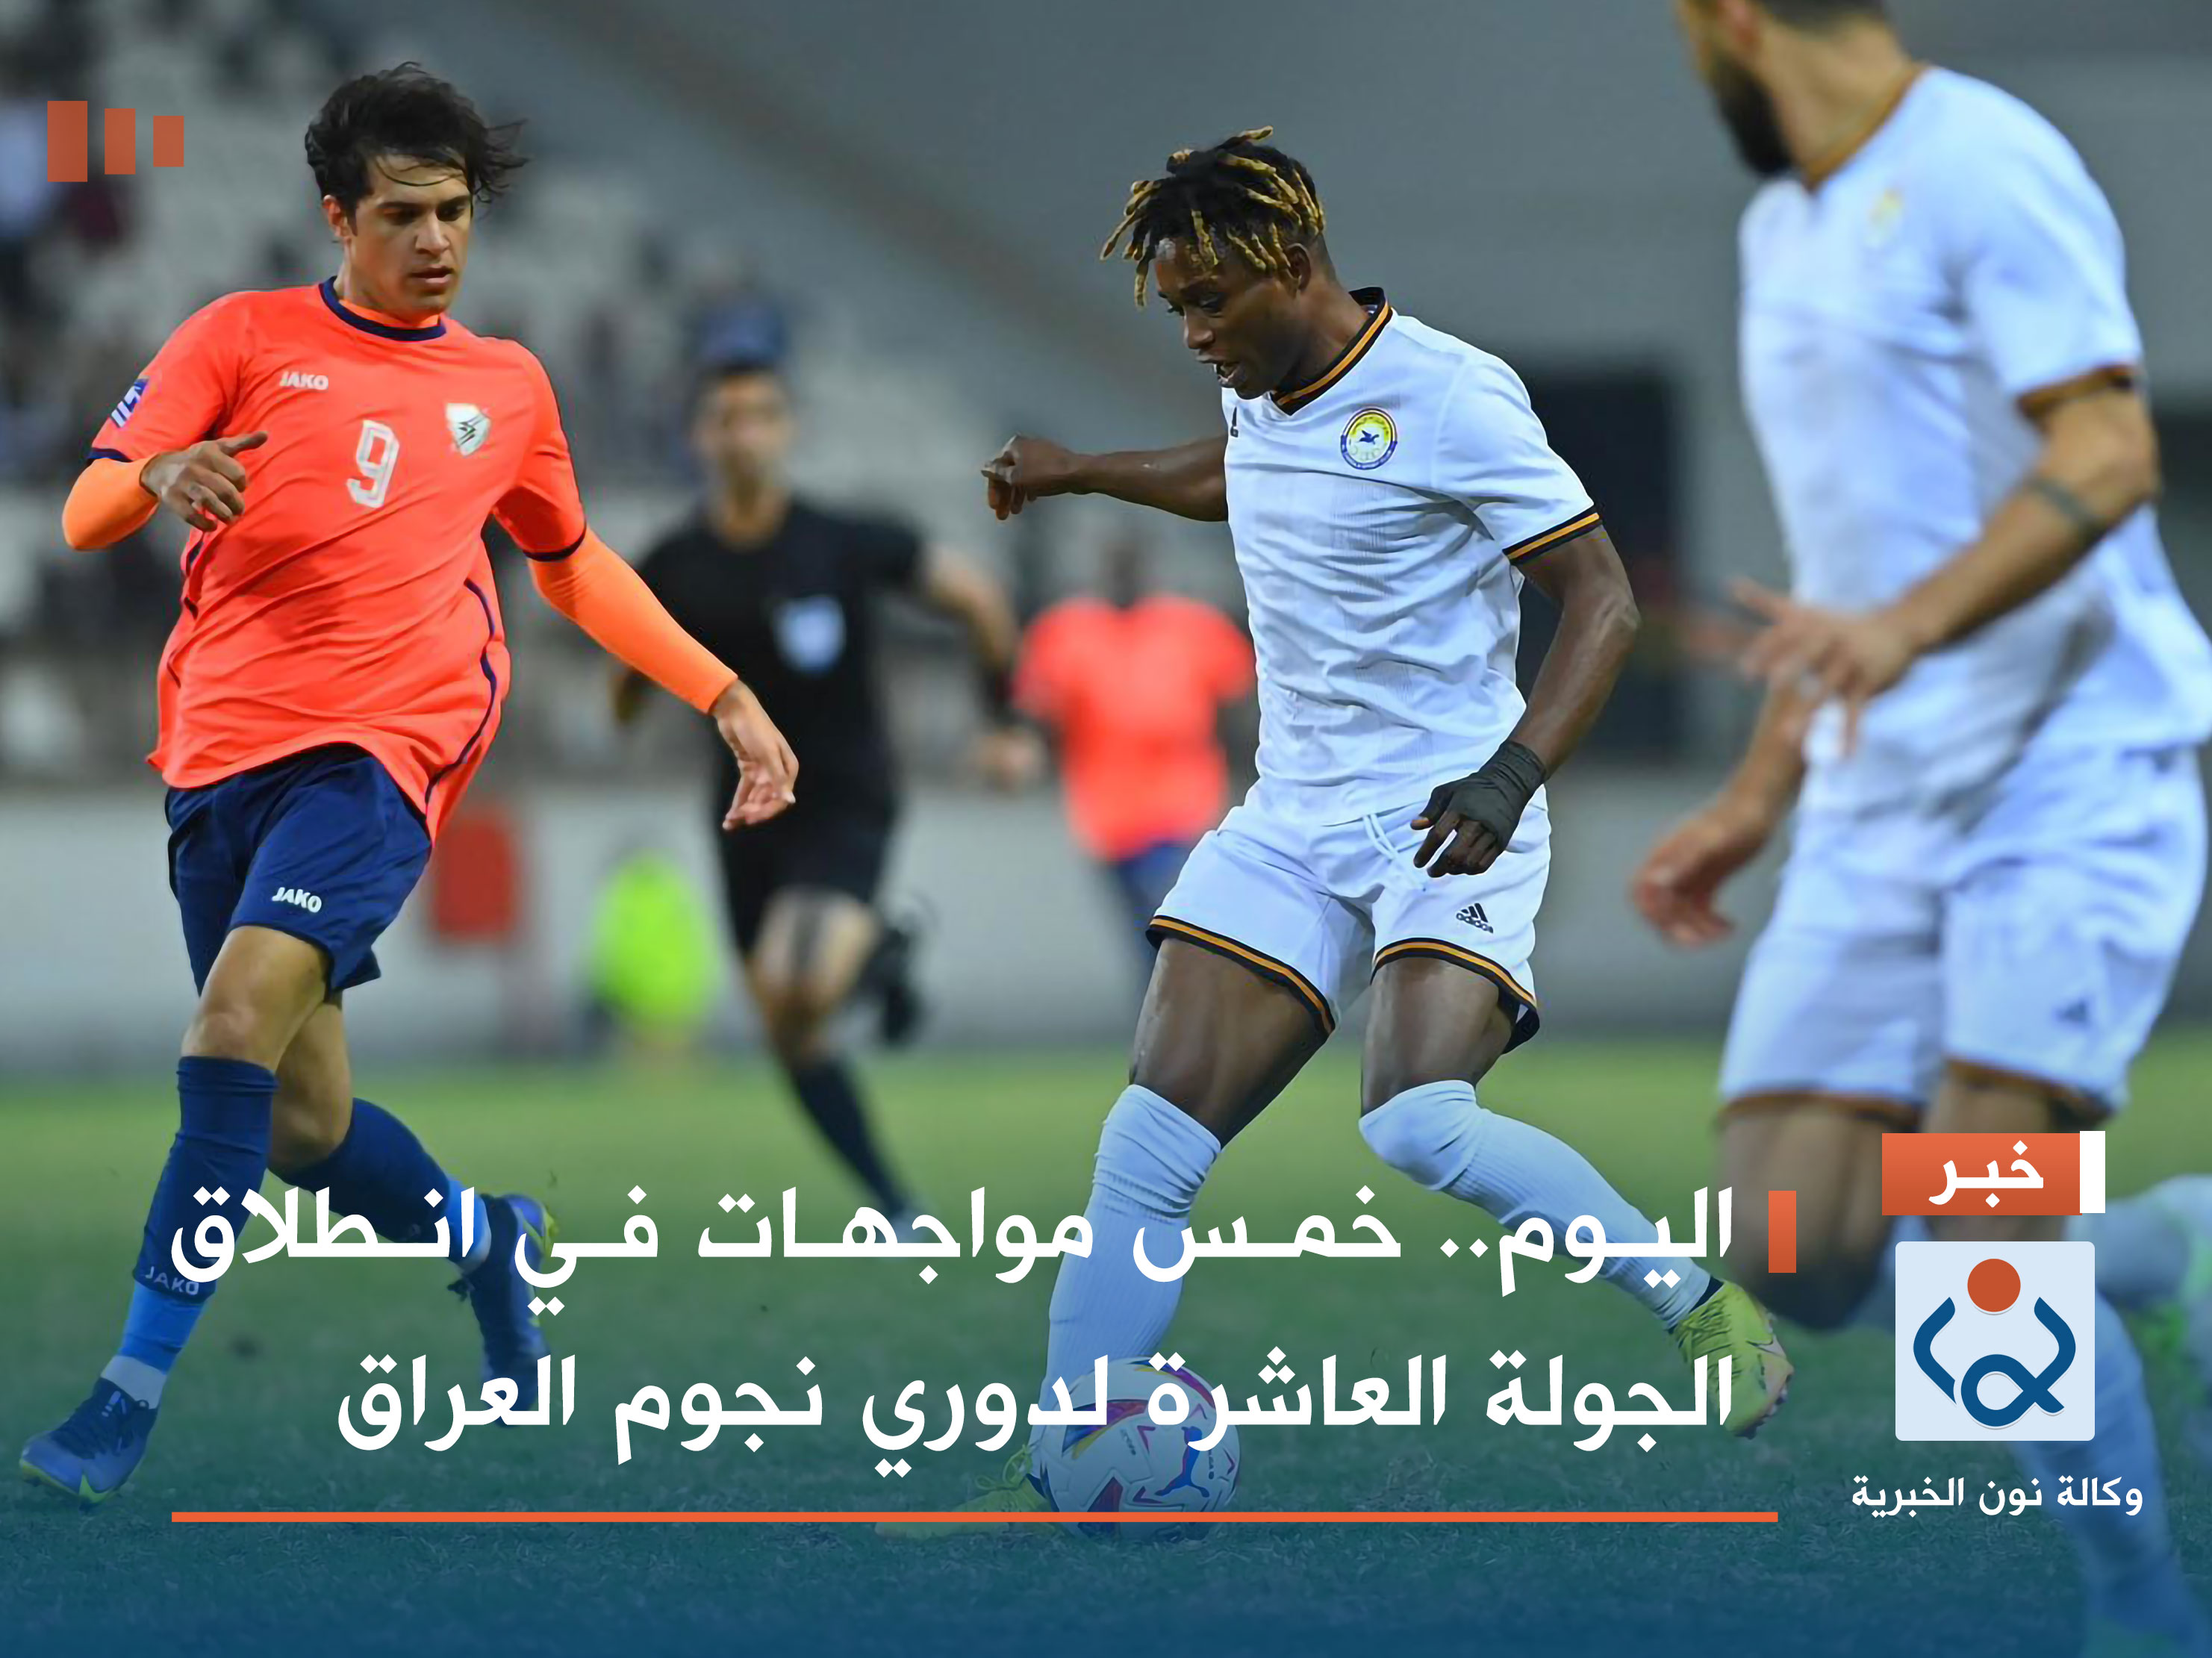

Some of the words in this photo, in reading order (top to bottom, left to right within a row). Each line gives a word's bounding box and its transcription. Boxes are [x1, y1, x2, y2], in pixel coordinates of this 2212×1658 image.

[279, 371, 328, 390] JAKO
[346, 419, 399, 508] 9
[271, 887, 322, 913] JAKO
[145, 1266, 199, 1295] JAKO
